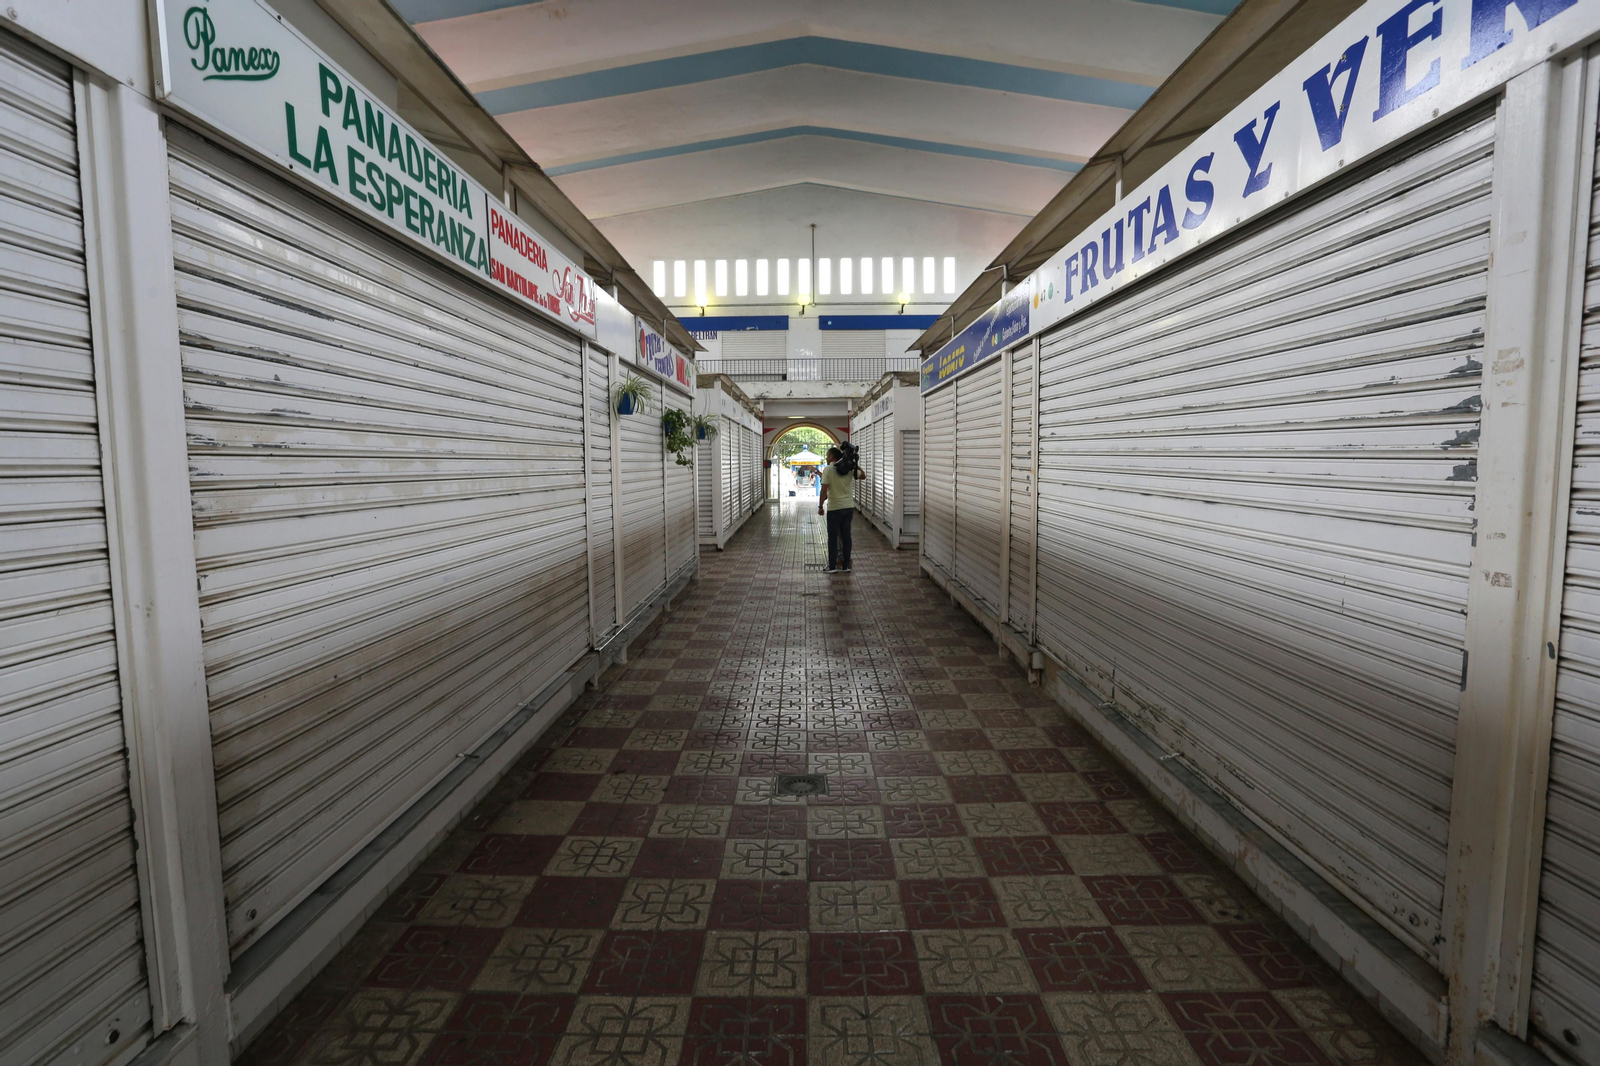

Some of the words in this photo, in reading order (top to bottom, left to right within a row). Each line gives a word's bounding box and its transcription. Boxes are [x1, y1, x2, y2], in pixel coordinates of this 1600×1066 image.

[184, 7, 281, 81] Panex
[285, 101, 340, 186] LA
[347, 144, 490, 276] ESPERANZA
[319, 62, 473, 220] PANADERIA
[491, 208, 549, 273] PANADERIA
[1064, 151, 1215, 304] FRUTAS
[1234, 100, 1280, 199] Y
[491, 257, 506, 284] SAN
